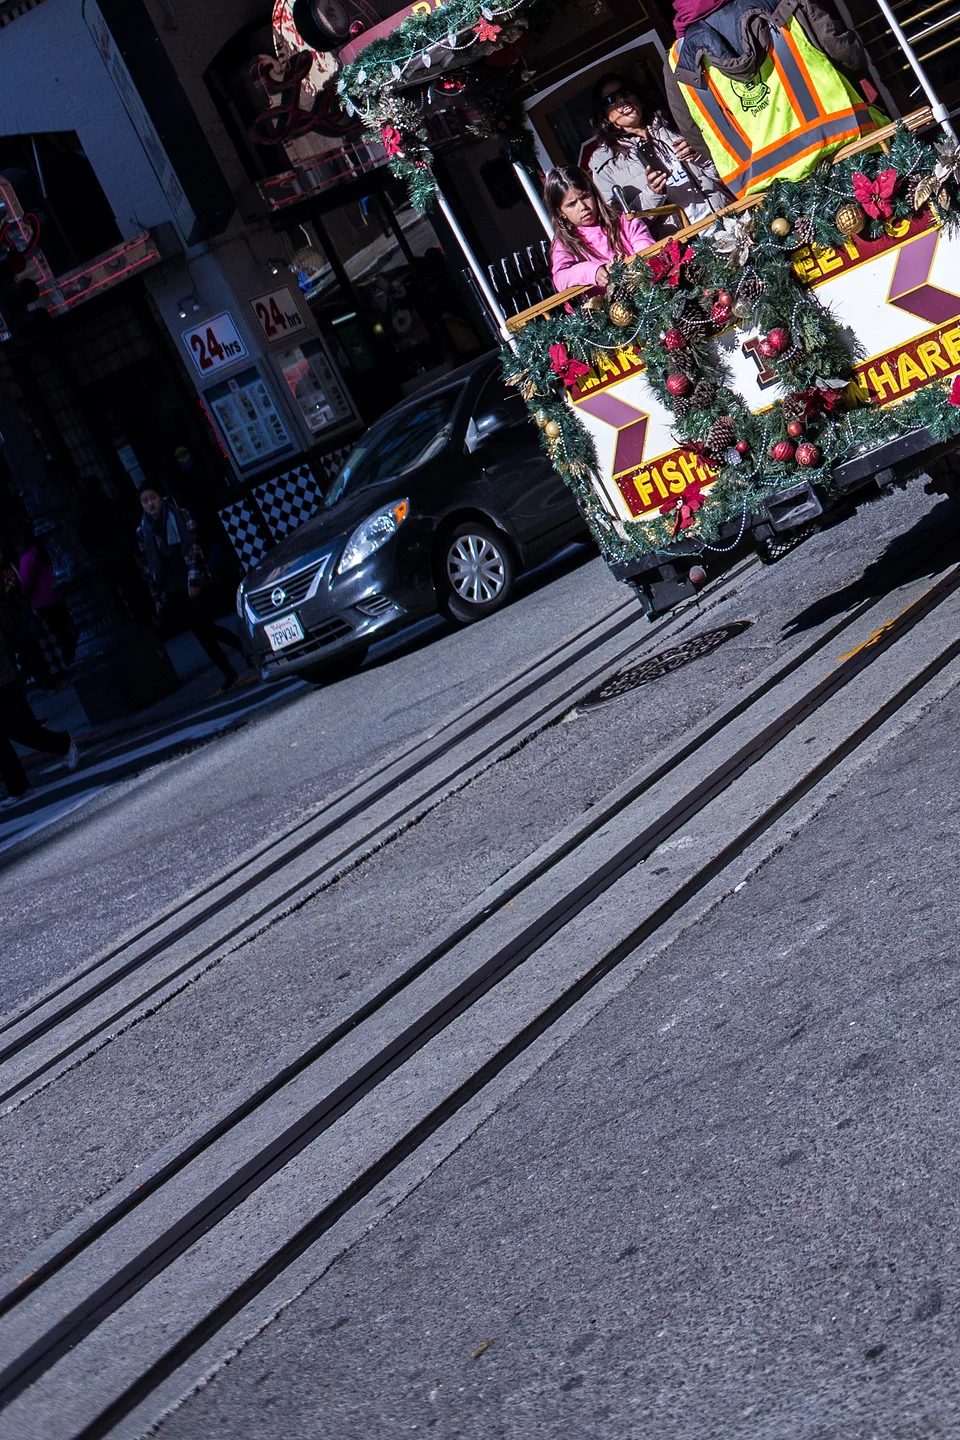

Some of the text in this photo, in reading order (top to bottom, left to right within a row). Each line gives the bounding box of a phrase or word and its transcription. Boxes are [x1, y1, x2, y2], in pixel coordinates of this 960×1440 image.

[255, 297, 302, 337] 24 hrs
[190, 327, 242, 370] 24 hrs
